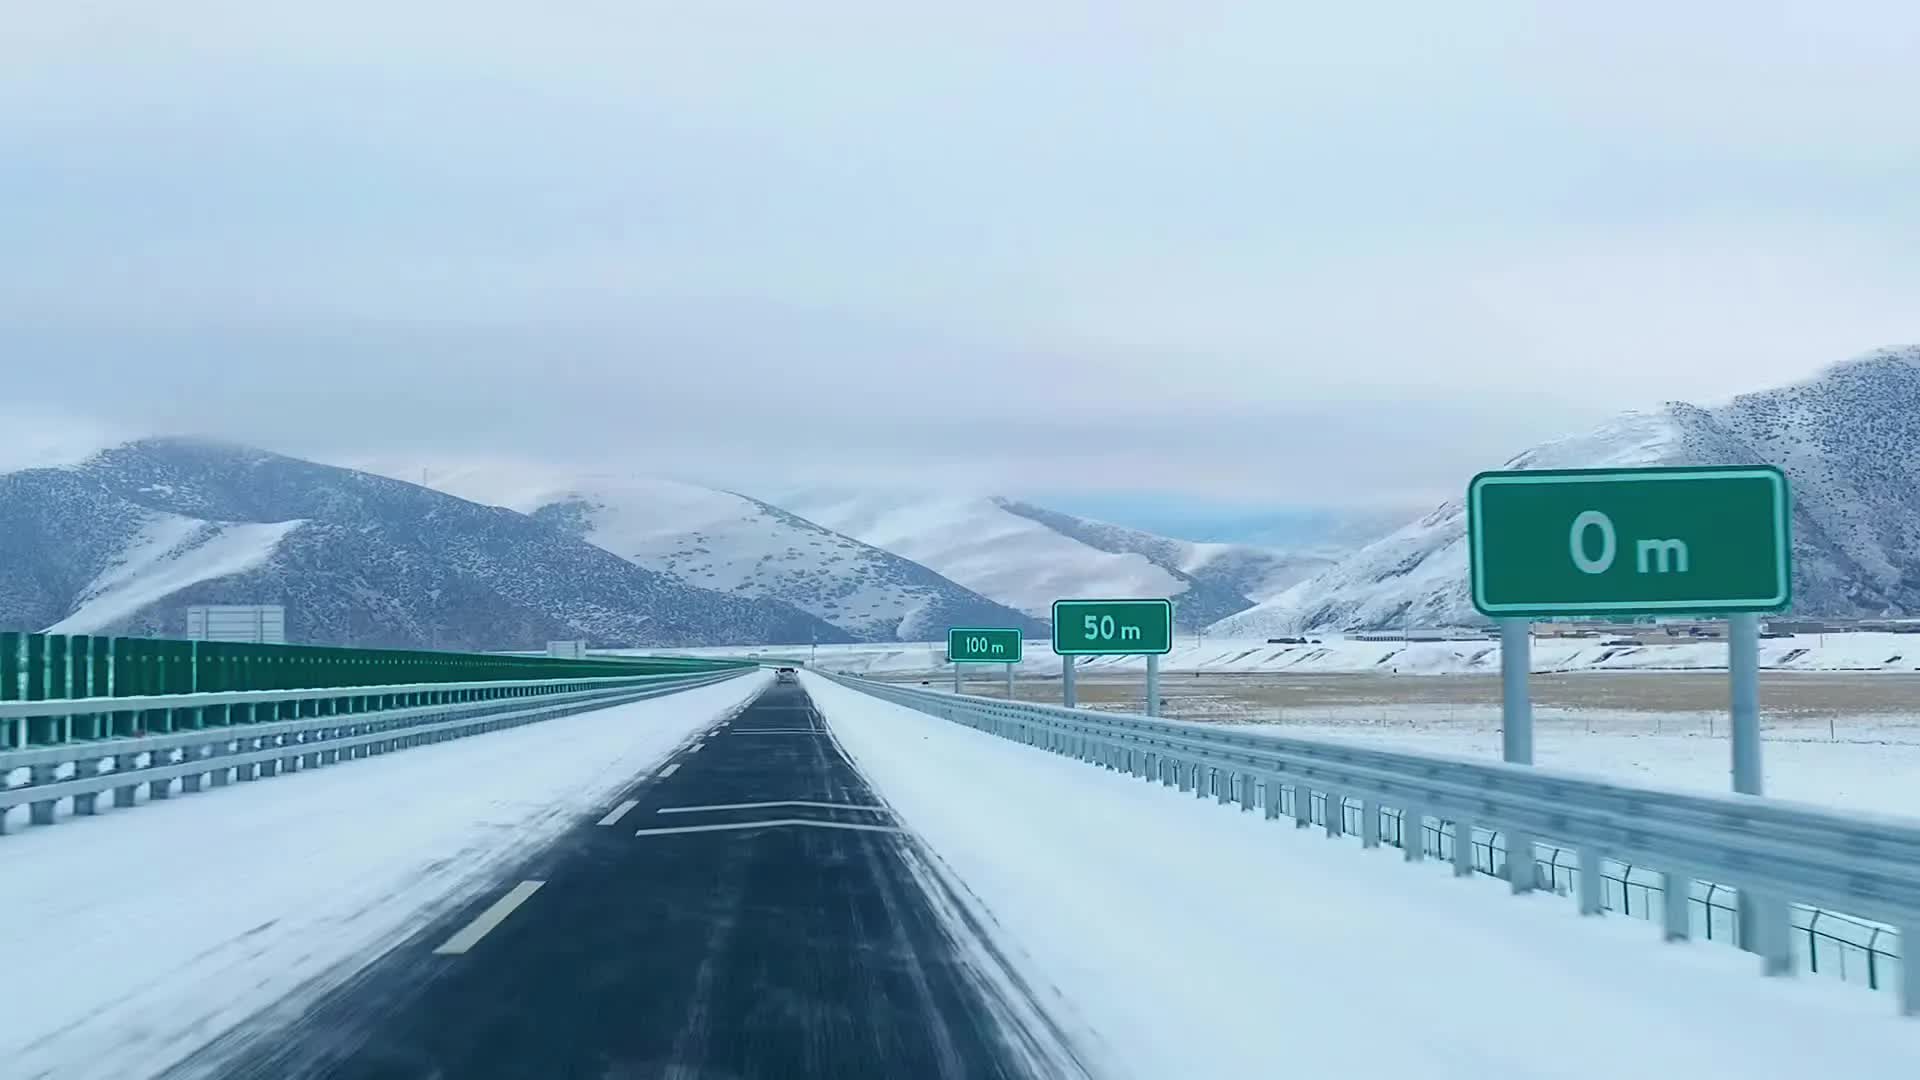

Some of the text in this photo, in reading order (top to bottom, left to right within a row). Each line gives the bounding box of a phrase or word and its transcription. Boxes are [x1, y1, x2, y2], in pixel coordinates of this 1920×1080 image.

[1570, 510, 1689, 574] 0 m
[1084, 615, 1140, 640] 50 m
[966, 637, 1003, 653] 100 m
